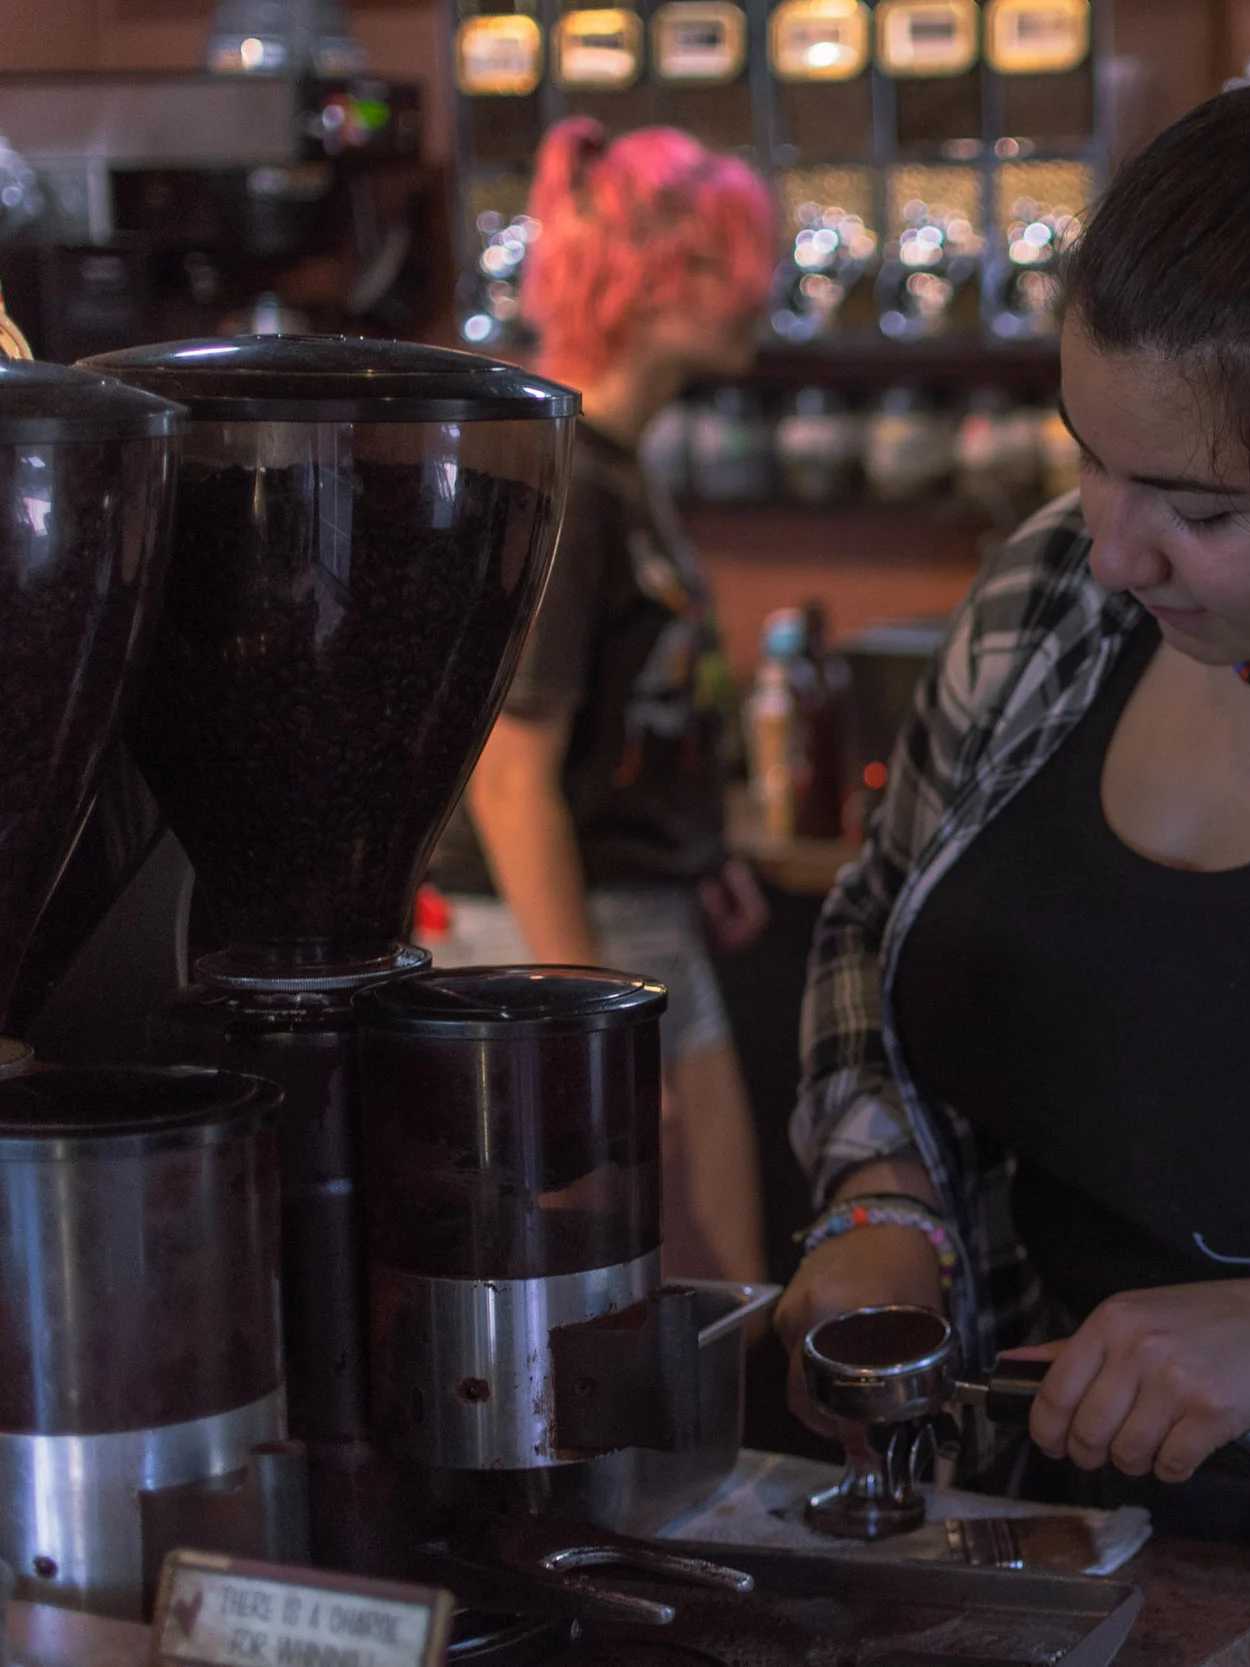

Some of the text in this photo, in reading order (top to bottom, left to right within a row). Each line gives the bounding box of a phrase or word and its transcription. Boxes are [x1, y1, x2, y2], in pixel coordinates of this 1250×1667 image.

[223, 1584, 271, 1621] THERE
[283, 1592, 302, 1626] IS
[308, 1601, 320, 1630] A
